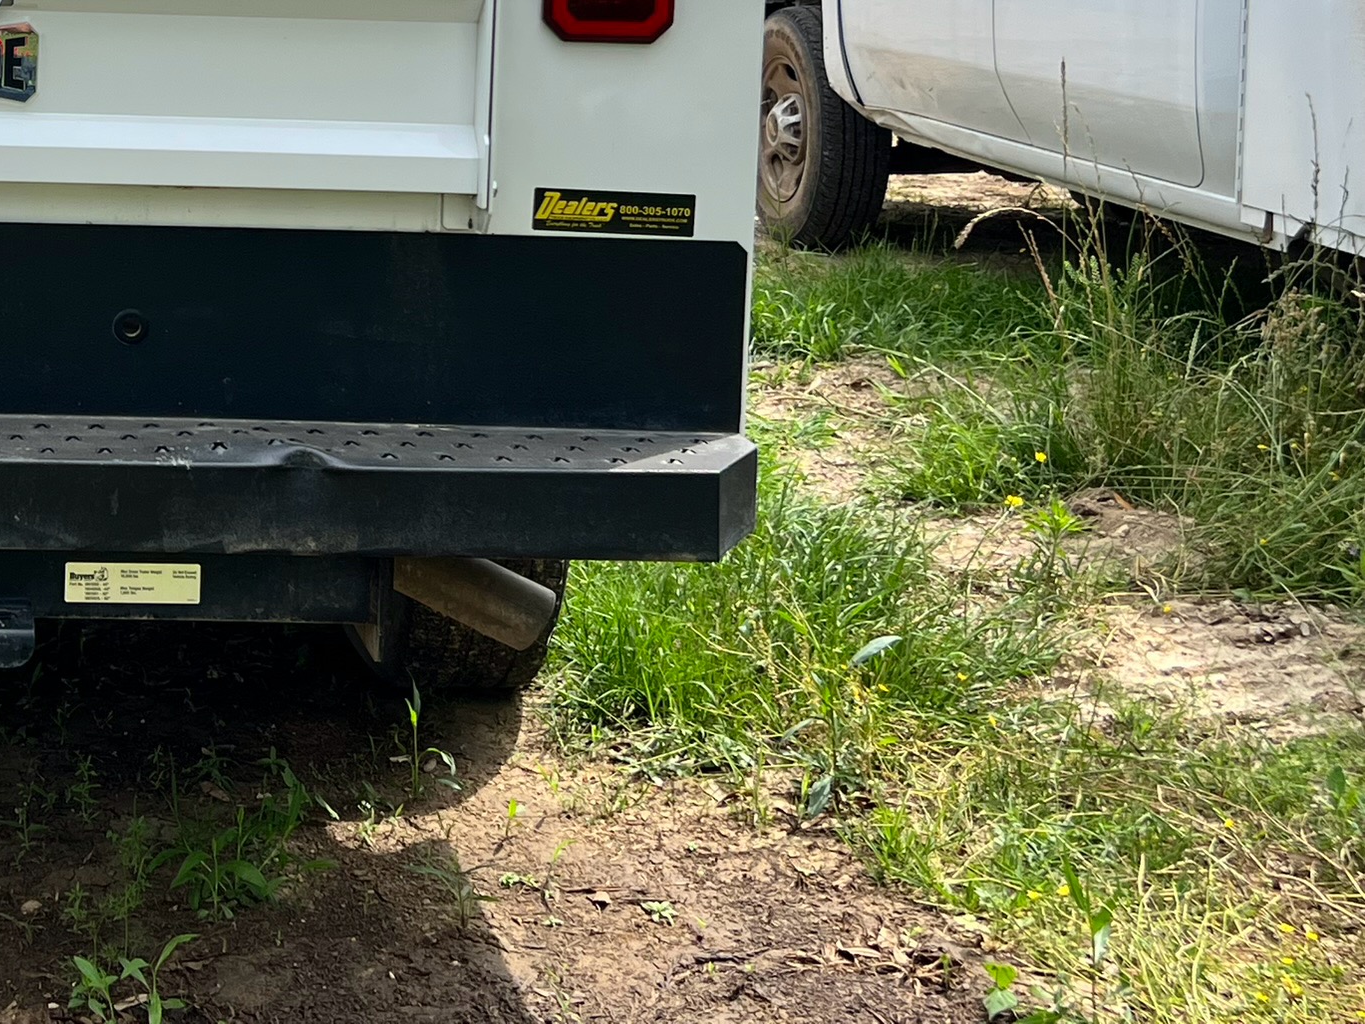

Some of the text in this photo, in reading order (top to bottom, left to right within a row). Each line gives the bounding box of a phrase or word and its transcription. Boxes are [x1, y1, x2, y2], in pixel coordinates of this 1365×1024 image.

[535, 192, 618, 222] Dealers
[620, 205, 691, 216] 800-305-1070
[69, 572, 95, 581] Buyers
